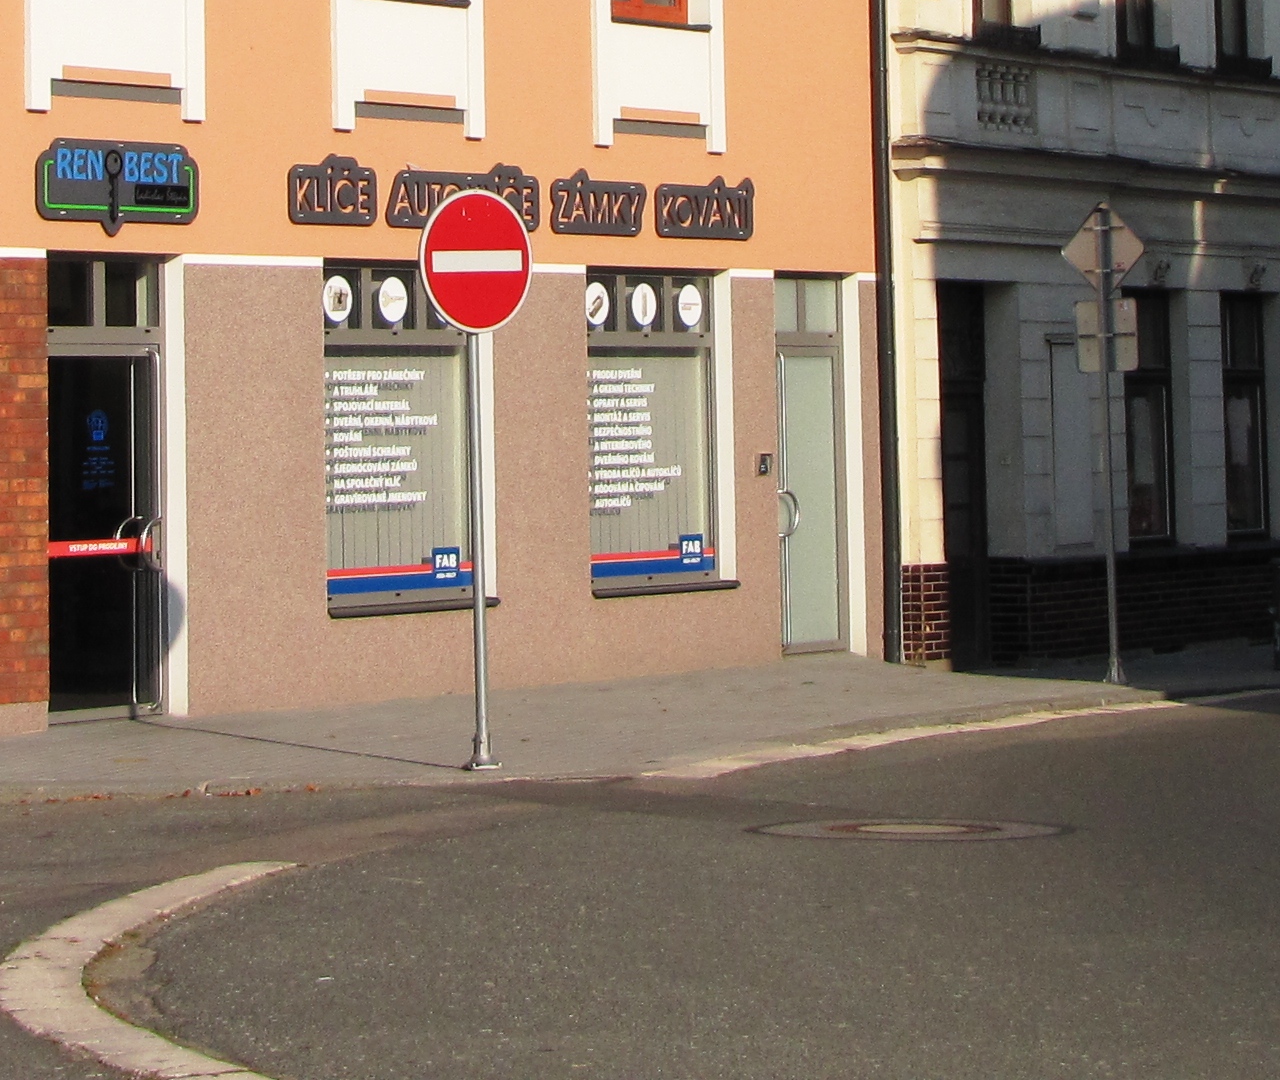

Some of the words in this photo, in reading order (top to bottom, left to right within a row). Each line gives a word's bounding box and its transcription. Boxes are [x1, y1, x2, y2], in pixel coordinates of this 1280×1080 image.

[296, 166, 369, 214] KLÍČE
[558, 180, 640, 224] ZÁMKY
[661, 187, 748, 229] KOVÁNÍ
[332, 369, 366, 381] POTŘEBY
[367, 370, 382, 380] PRO
[383, 368, 425, 380] ZÁMEČNÍKY
[592, 369, 617, 379] PRODEJ
[333, 386, 339, 396] A
[340, 383, 378, 396] TRUHLÁŘE
[592, 384, 598, 393] A
[333, 399, 374, 411] SPOJOVACÍ
[375, 399, 410, 411] MATERIÁL
[593, 398, 620, 408] OPRAVY
[620, 398, 626, 407] A
[626, 397, 648, 407] SERVIS
[395, 413, 438, 426] NÁBYTKOVÉ
[593, 411, 622, 422] MONTÁŽ
[622, 413, 628, 422] A
[628, 412, 651, 422] SERVIS
[333, 430, 363, 442] KOVÁNÍ
[333, 445, 372, 458] POŠTOVNÍ
[372, 445, 411, 456] SCHRÁNKY
[593, 441, 599, 451] A
[391, 459, 418, 472] ZÁMKŮ
[641, 468, 646, 478] A
[334, 479, 345, 489] NA
[346, 476, 384, 489] SPOLEČNÝ
[629, 482, 634, 492] A
[387, 491, 428, 502] JMENOVKY
[681, 540, 701, 554] FAB
[435, 553, 457, 568] FAB
